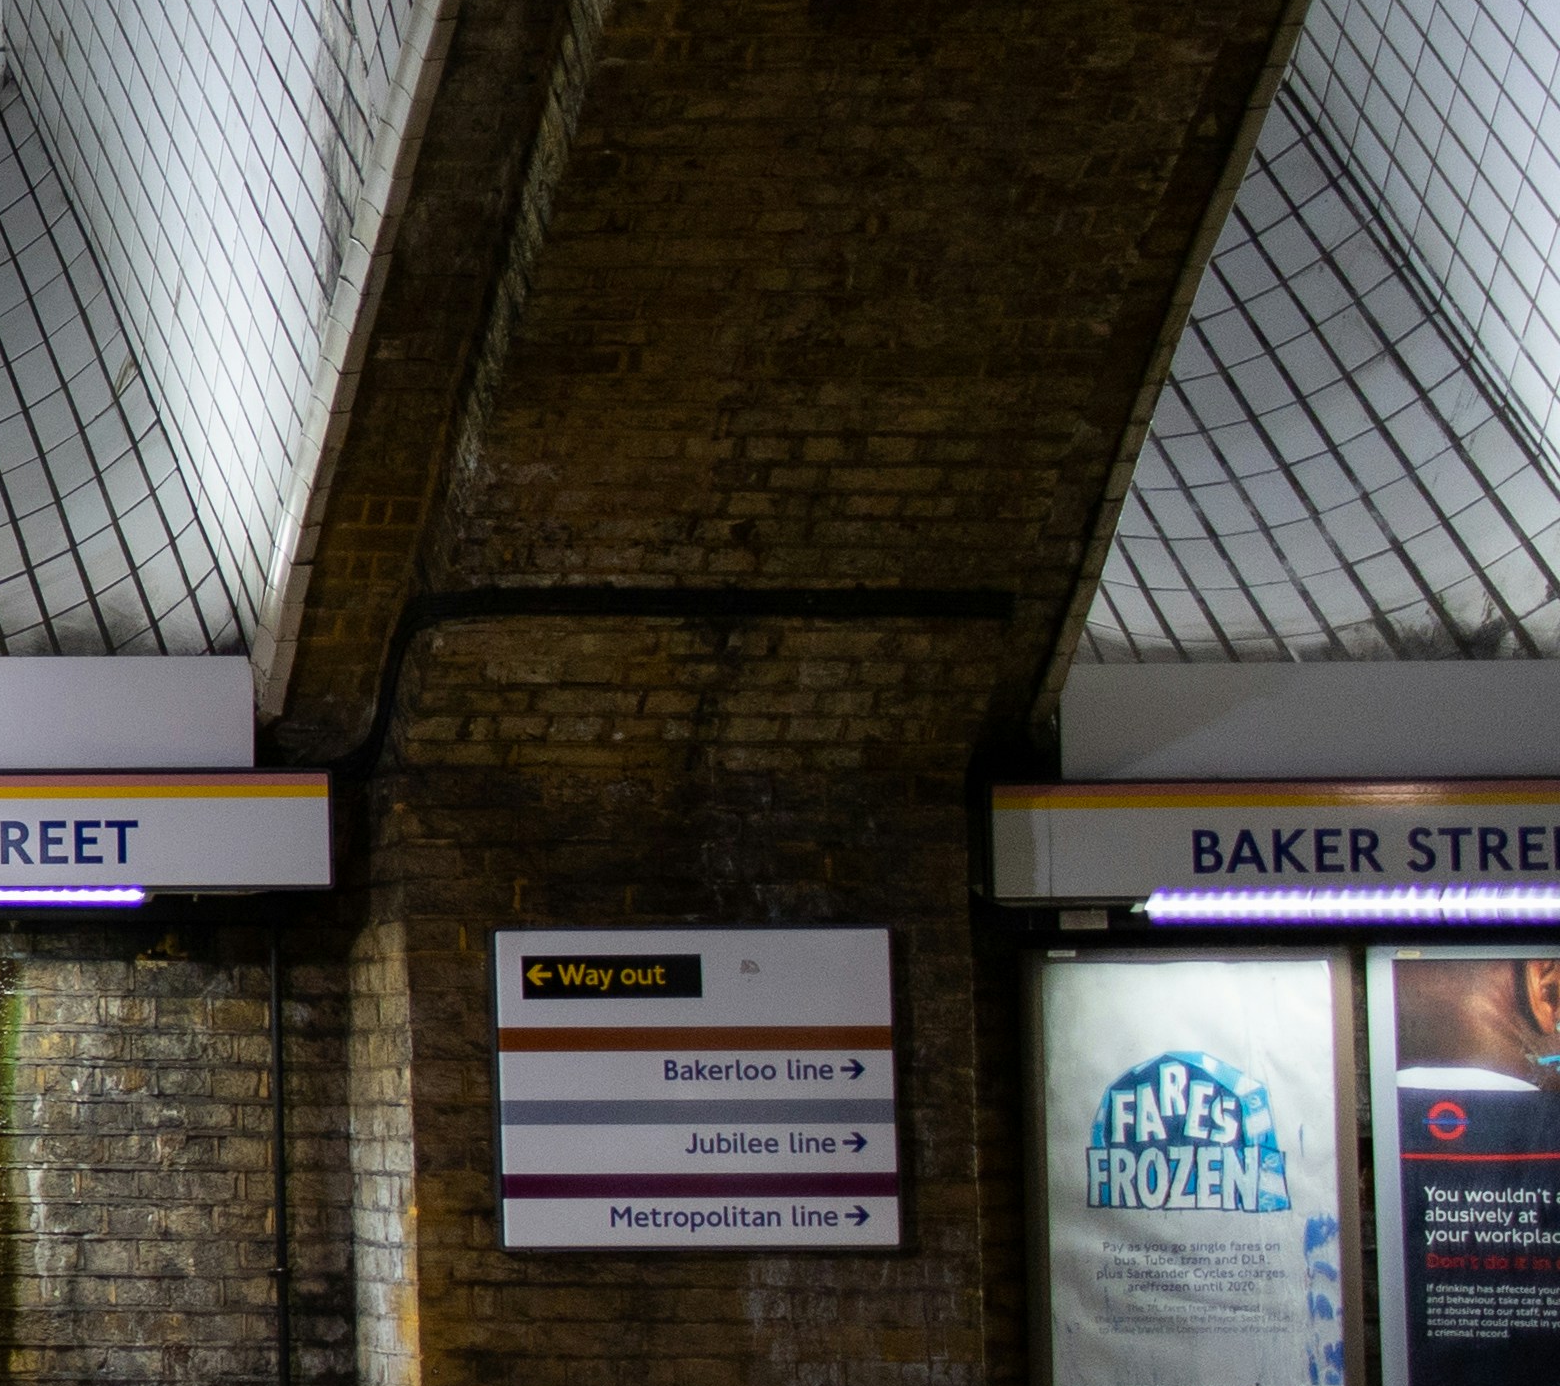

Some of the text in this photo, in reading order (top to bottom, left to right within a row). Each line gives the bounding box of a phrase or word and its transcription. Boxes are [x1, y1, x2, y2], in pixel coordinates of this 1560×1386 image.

[1192, 826, 1560, 874] BAKER STRE
[558, 964, 665, 990] Way out
[664, 1059, 833, 1080] Bakerloo line
[1110, 1061, 1238, 1144] FARES
[685, 1132, 836, 1154] Jubilee line
[1088, 1145, 1259, 1211] FROZEN
[1424, 1186, 1550, 1203] You wouldn't
[611, 1205, 838, 1233] Metropolitan line
[1425, 1207, 1537, 1225] abusively at
[1425, 1230, 1469, 1245] your
[1427, 1284, 1560, 1295] If drinking has affected your
